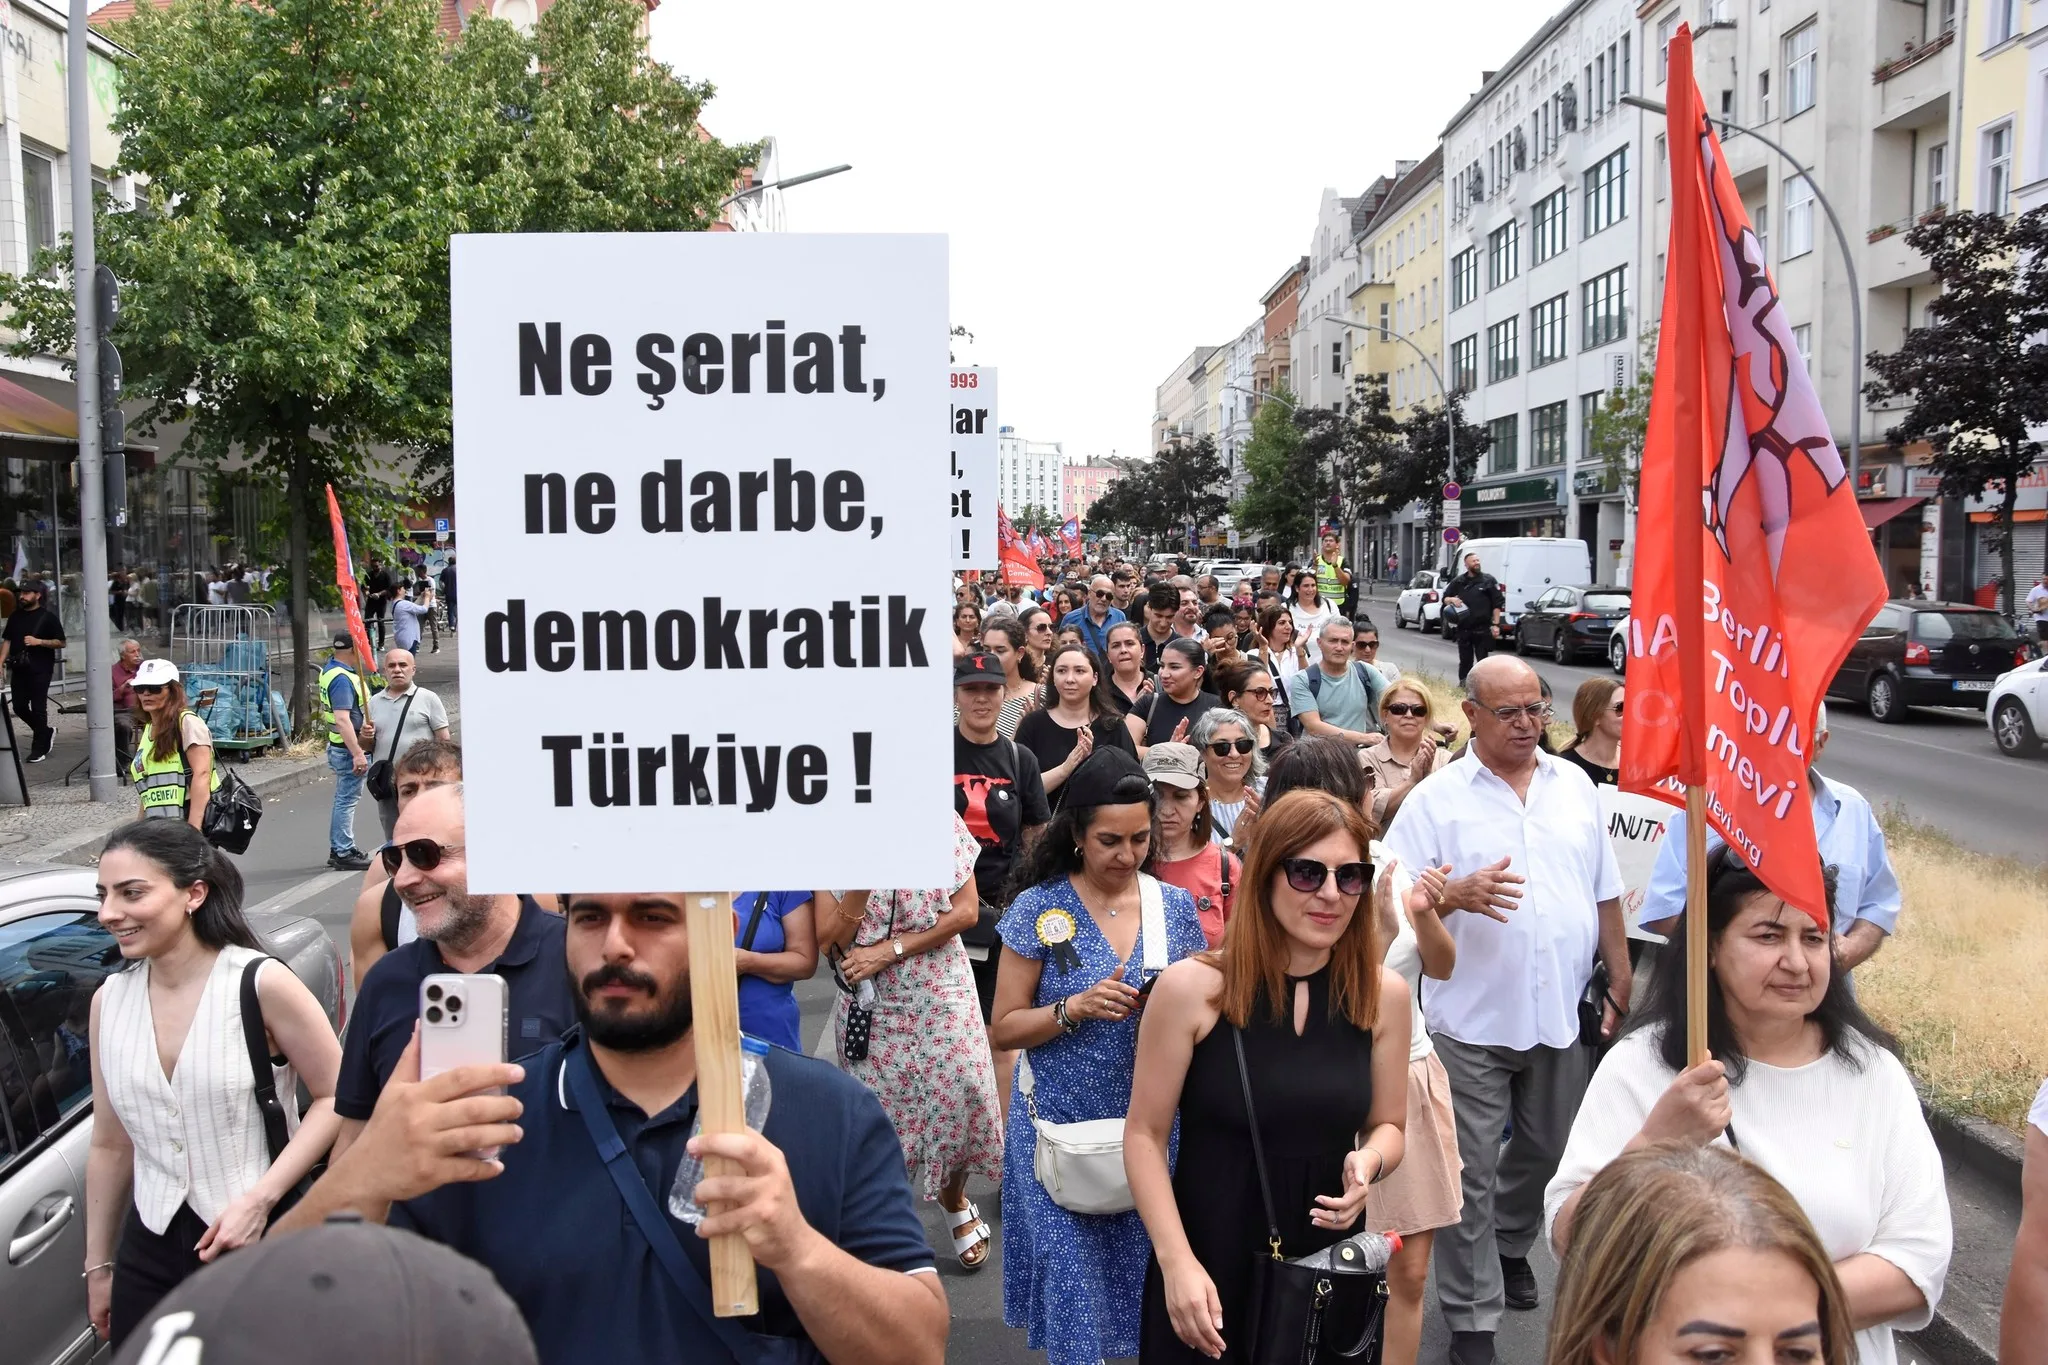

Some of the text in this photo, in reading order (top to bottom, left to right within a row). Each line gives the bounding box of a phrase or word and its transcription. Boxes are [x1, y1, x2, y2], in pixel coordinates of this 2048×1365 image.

[519, 321, 886, 411] Ne şeriat,
[525, 460, 883, 540] ne darbe,
[485, 596, 928, 673] demokratik
[542, 732, 872, 813] Türkiye !
